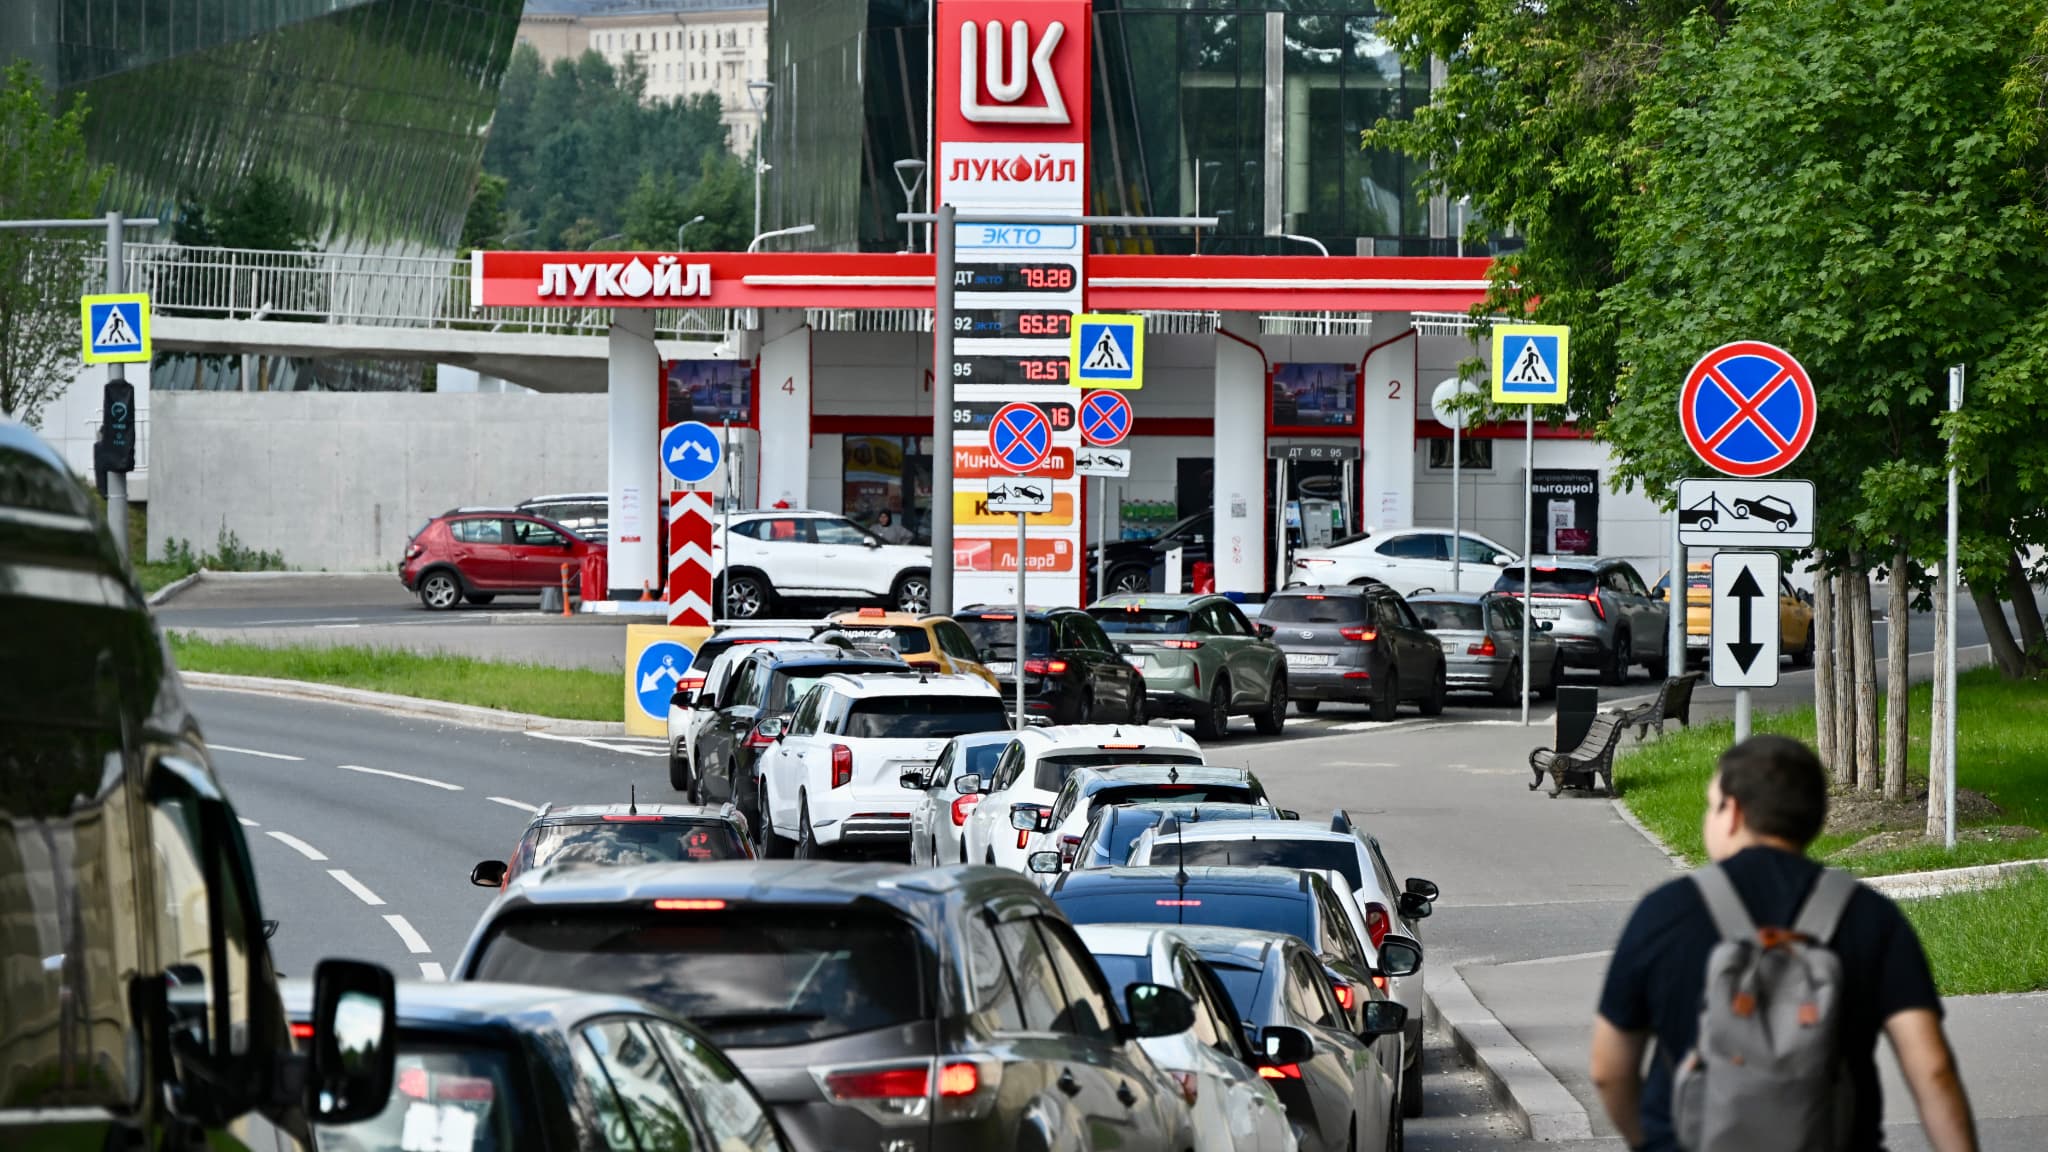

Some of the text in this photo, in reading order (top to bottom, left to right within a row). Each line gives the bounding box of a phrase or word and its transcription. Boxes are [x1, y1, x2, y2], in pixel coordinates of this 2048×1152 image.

[949, 153, 1075, 182] ЛУКОЙЛ
[982, 228, 1041, 245] ЭКТО
[537, 254, 711, 297] ЛУКОЙЛ
[954, 270, 975, 286] ДТ
[1020, 268, 1072, 288] 79.28
[954, 316, 972, 331] 92
[1019, 314, 1070, 334] 65.27
[953, 361, 1070, 380] 95 72.57
[781, 376, 796, 396] 4
[1388, 379, 1401, 400] 2
[953, 410, 971, 423] 95
[1288, 448, 1342, 458] ДТ 92 95
[1532, 481, 1594, 495] выгодно!
